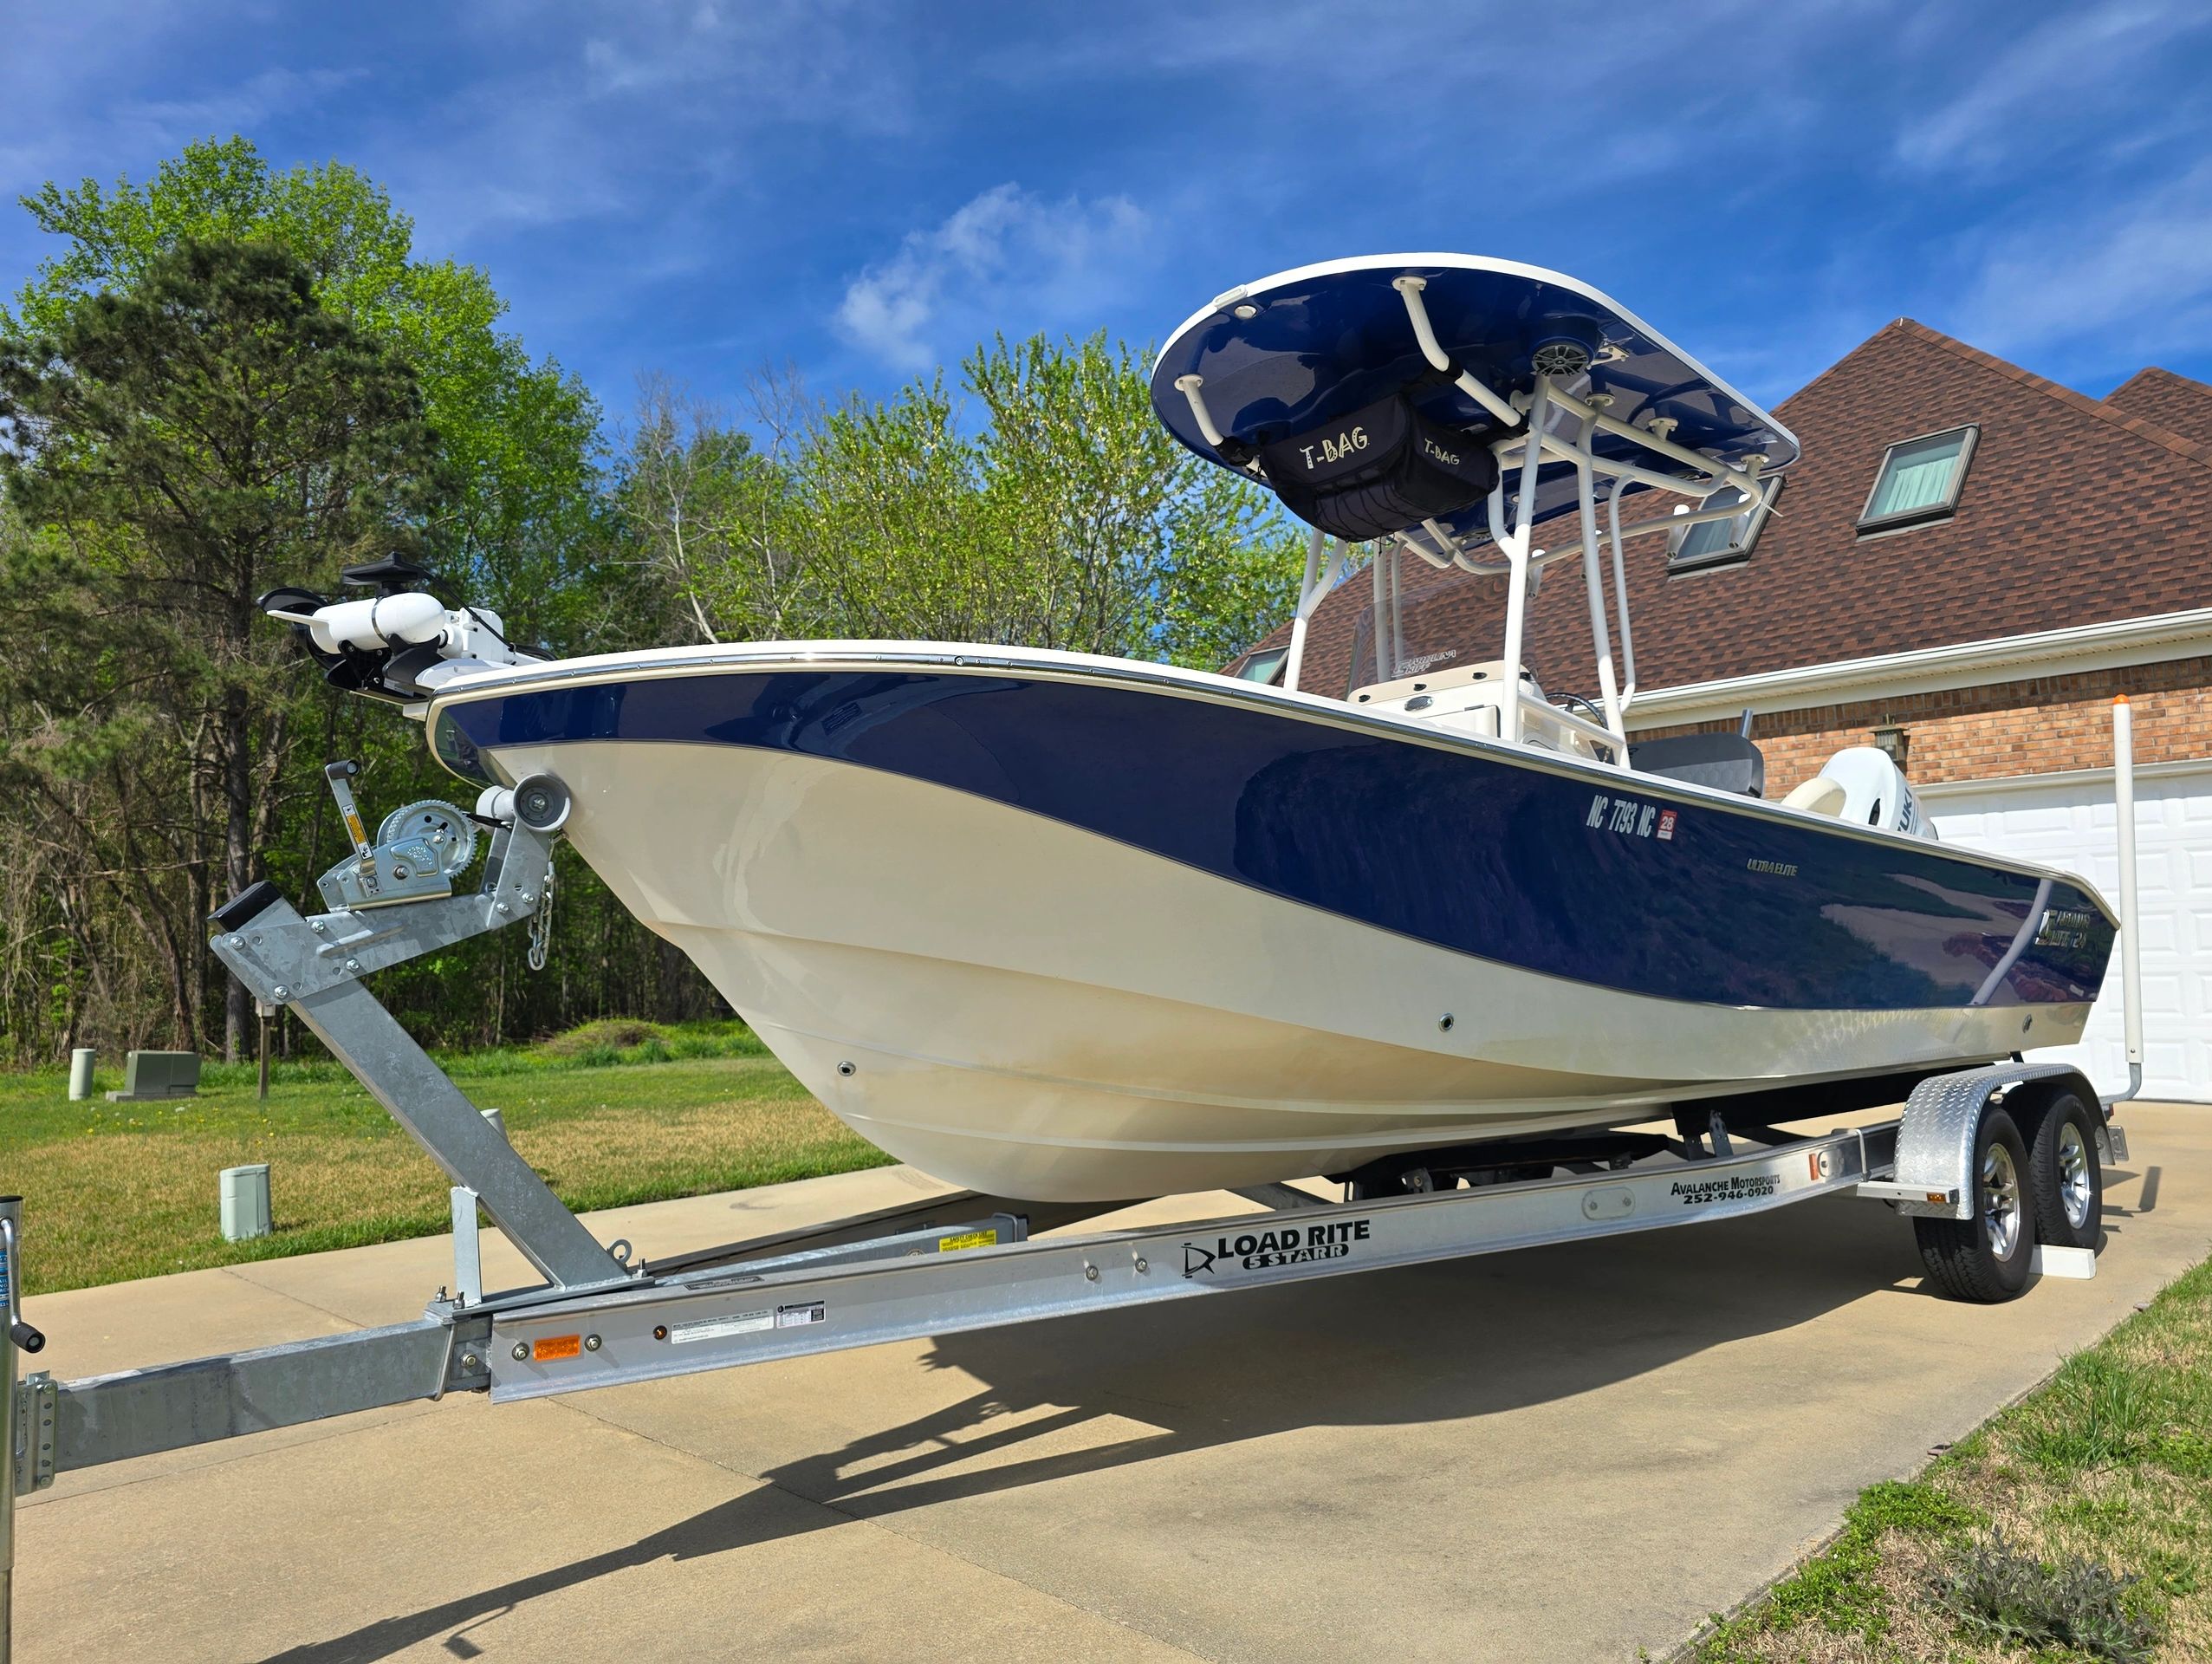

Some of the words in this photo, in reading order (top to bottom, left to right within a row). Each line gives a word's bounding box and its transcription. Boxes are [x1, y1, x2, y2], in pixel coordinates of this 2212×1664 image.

[1299, 426, 1368, 469] T-BAG
[1424, 438, 1460, 465] T-BAG
[1586, 795, 1609, 829] NC
[1608, 799, 1638, 835] 7793
[1636, 804, 1657, 838] NC
[1897, 786, 1913, 831] UKI
[1660, 816, 1675, 831] 28
[1747, 858, 1774, 874] ULTRA
[1774, 863, 1799, 876] ELITE
[1670, 1181, 1729, 1196] AVALANCHE
[1730, 1174, 1781, 1190] MOTORSPORTS
[1683, 1186, 1774, 1205] 252-946-0920
[1217, 1229, 1301, 1259] LOAD
[1307, 1219, 1371, 1247] RITE
[1249, 1256, 1262, 1270] 5
[1268, 1244, 1344, 1267] STARR
